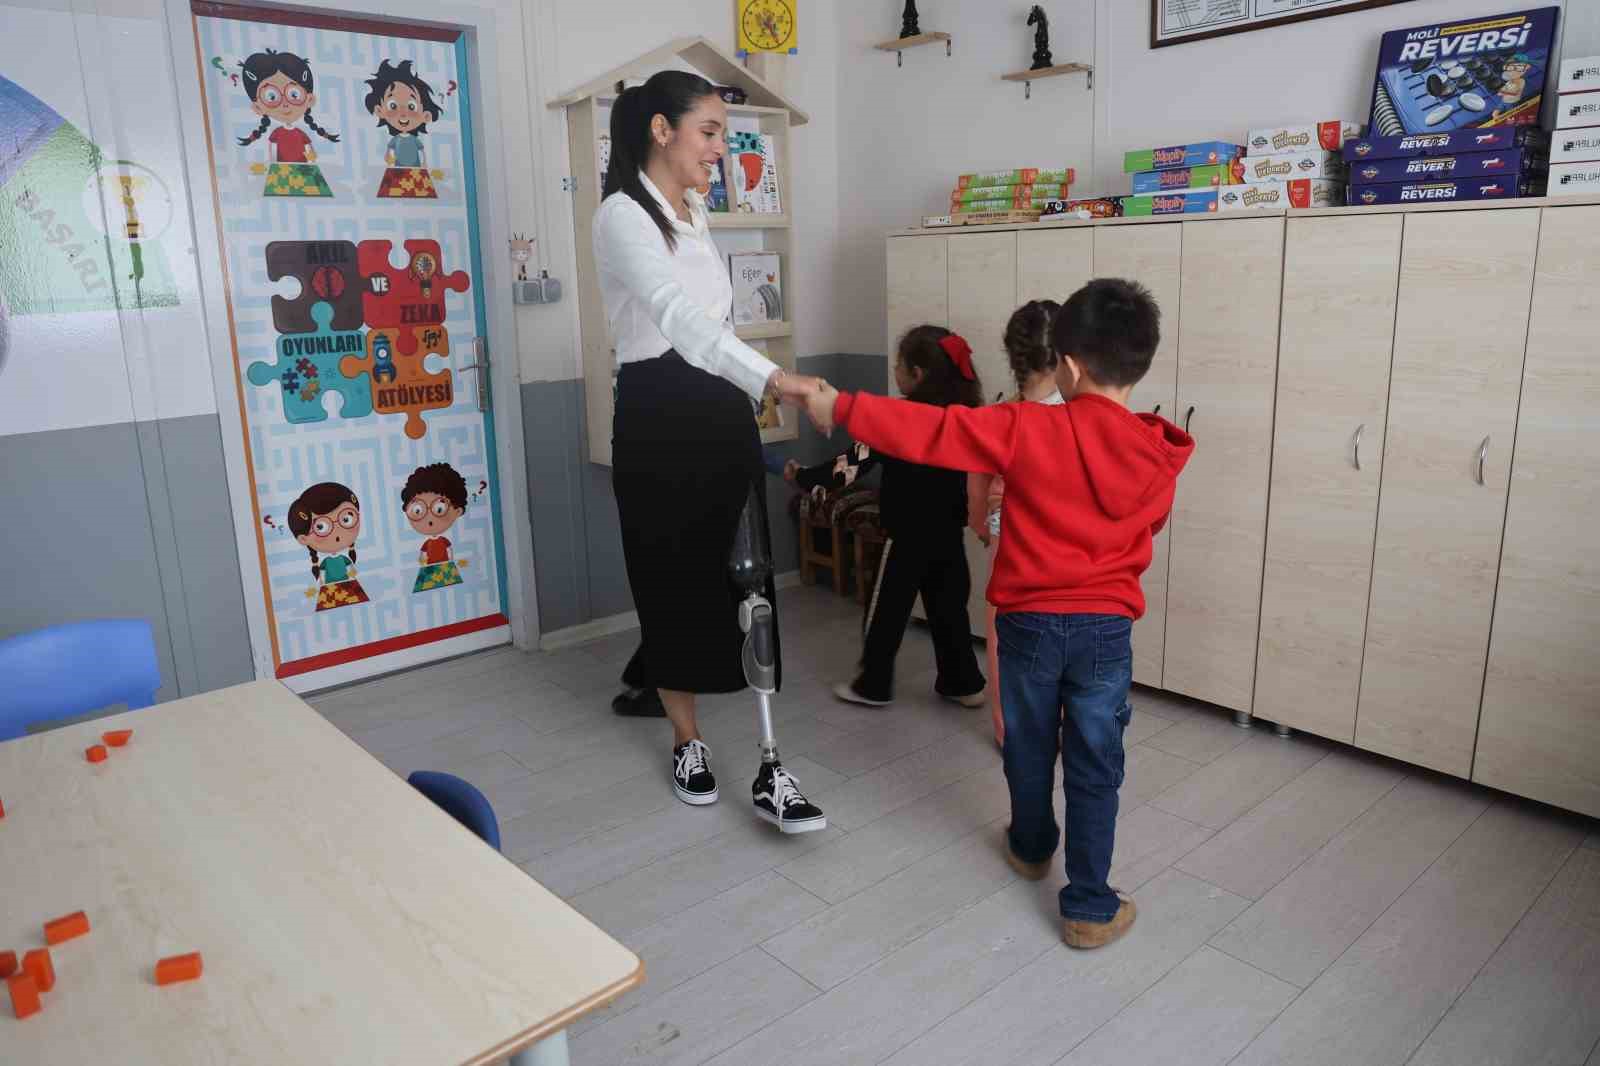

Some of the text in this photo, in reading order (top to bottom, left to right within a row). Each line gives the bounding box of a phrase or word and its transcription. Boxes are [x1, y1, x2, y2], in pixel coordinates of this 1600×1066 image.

[306, 244, 349, 264] AKIL
[371, 276, 389, 292] VE
[400, 303, 440, 324] ZEKA
[282, 334, 363, 356] OYUNLARI
[377, 380, 450, 408] ATÖLYESİ
